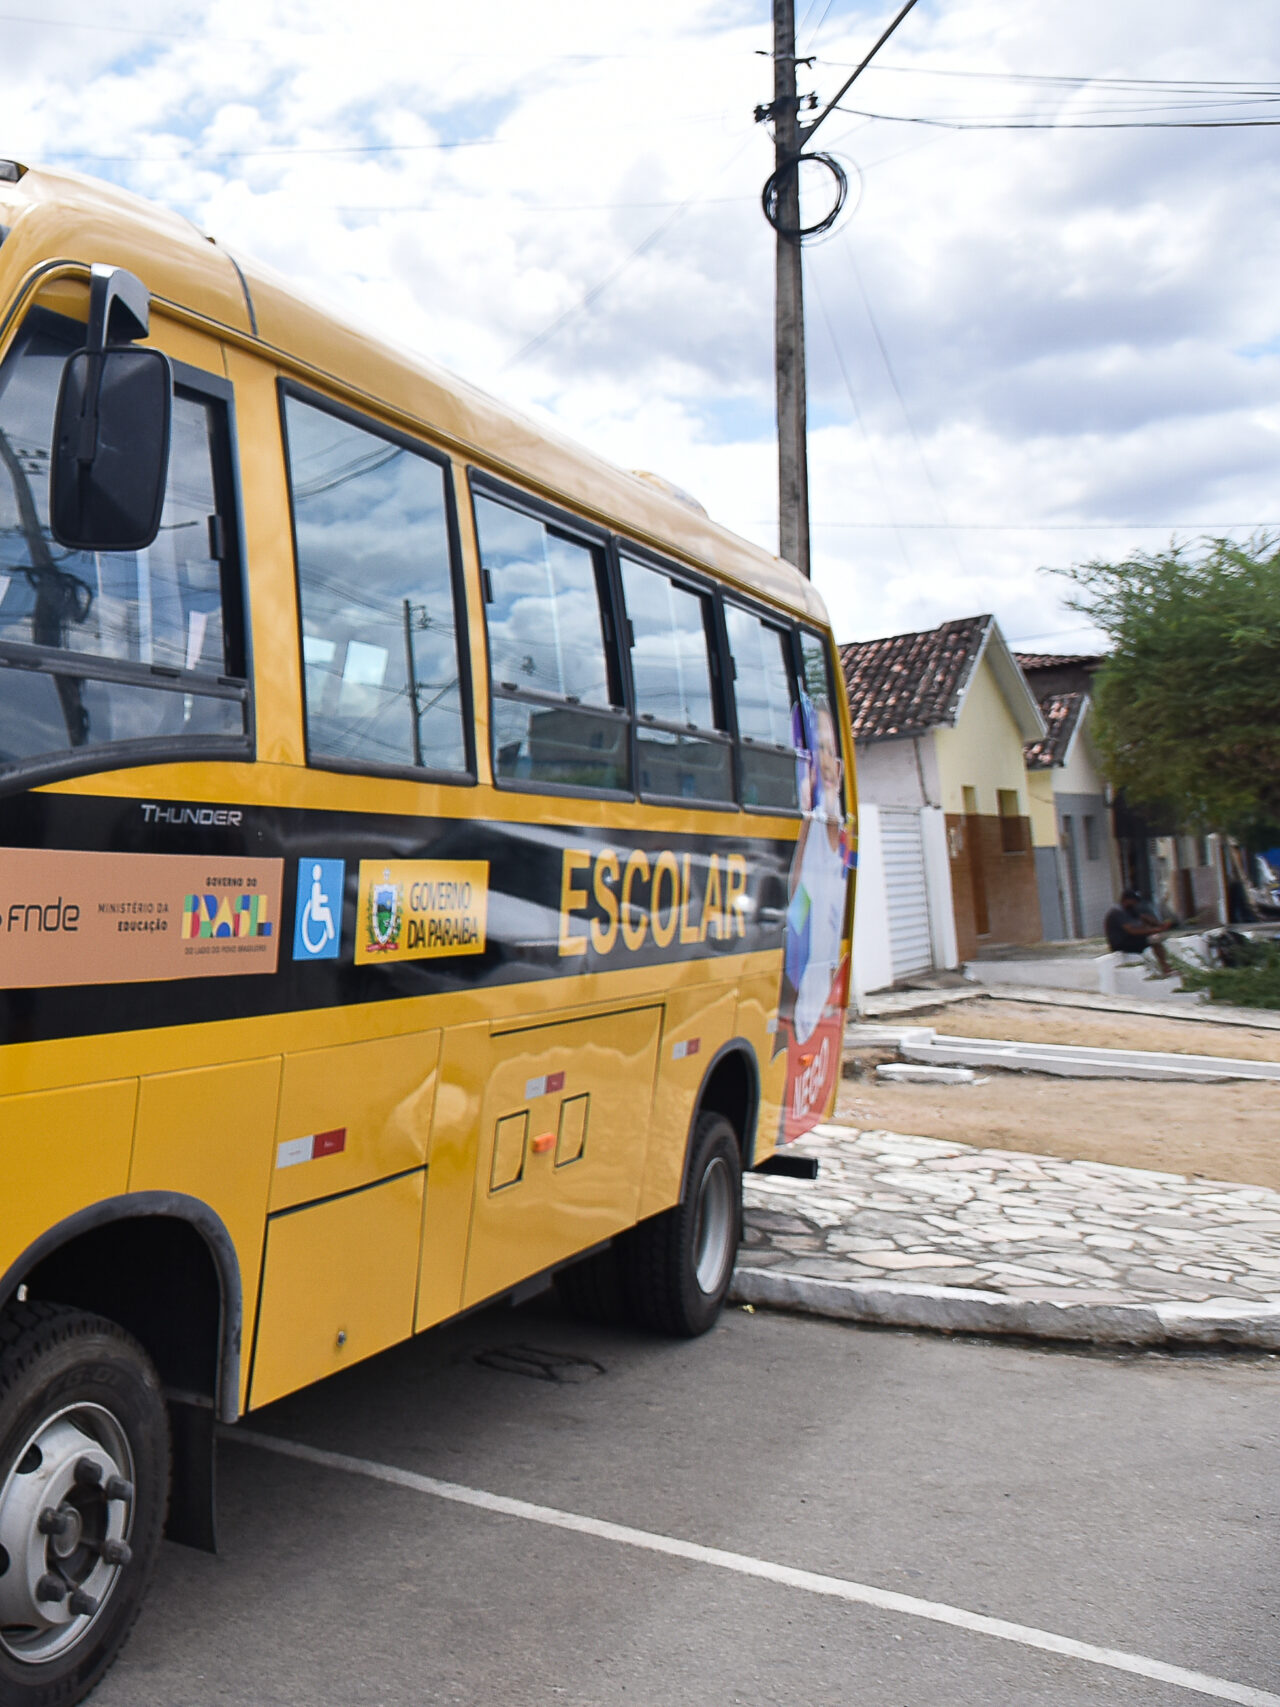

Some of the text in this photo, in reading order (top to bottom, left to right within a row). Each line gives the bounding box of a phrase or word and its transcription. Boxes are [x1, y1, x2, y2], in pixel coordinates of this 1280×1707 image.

[141, 804, 243, 826] THUNDER
[206, 877, 257, 887] GOVERNO DO
[410, 882, 471, 911] GOVERNO
[7, 897, 80, 932] fnde
[98, 902, 169, 914] MINISTÉRIO DA
[181, 894, 272, 939] BRASIL
[557, 848, 748, 957] ESCOLAR
[118, 918, 168, 933] EDUCAÇÃO
[407, 919, 426, 949] DA
